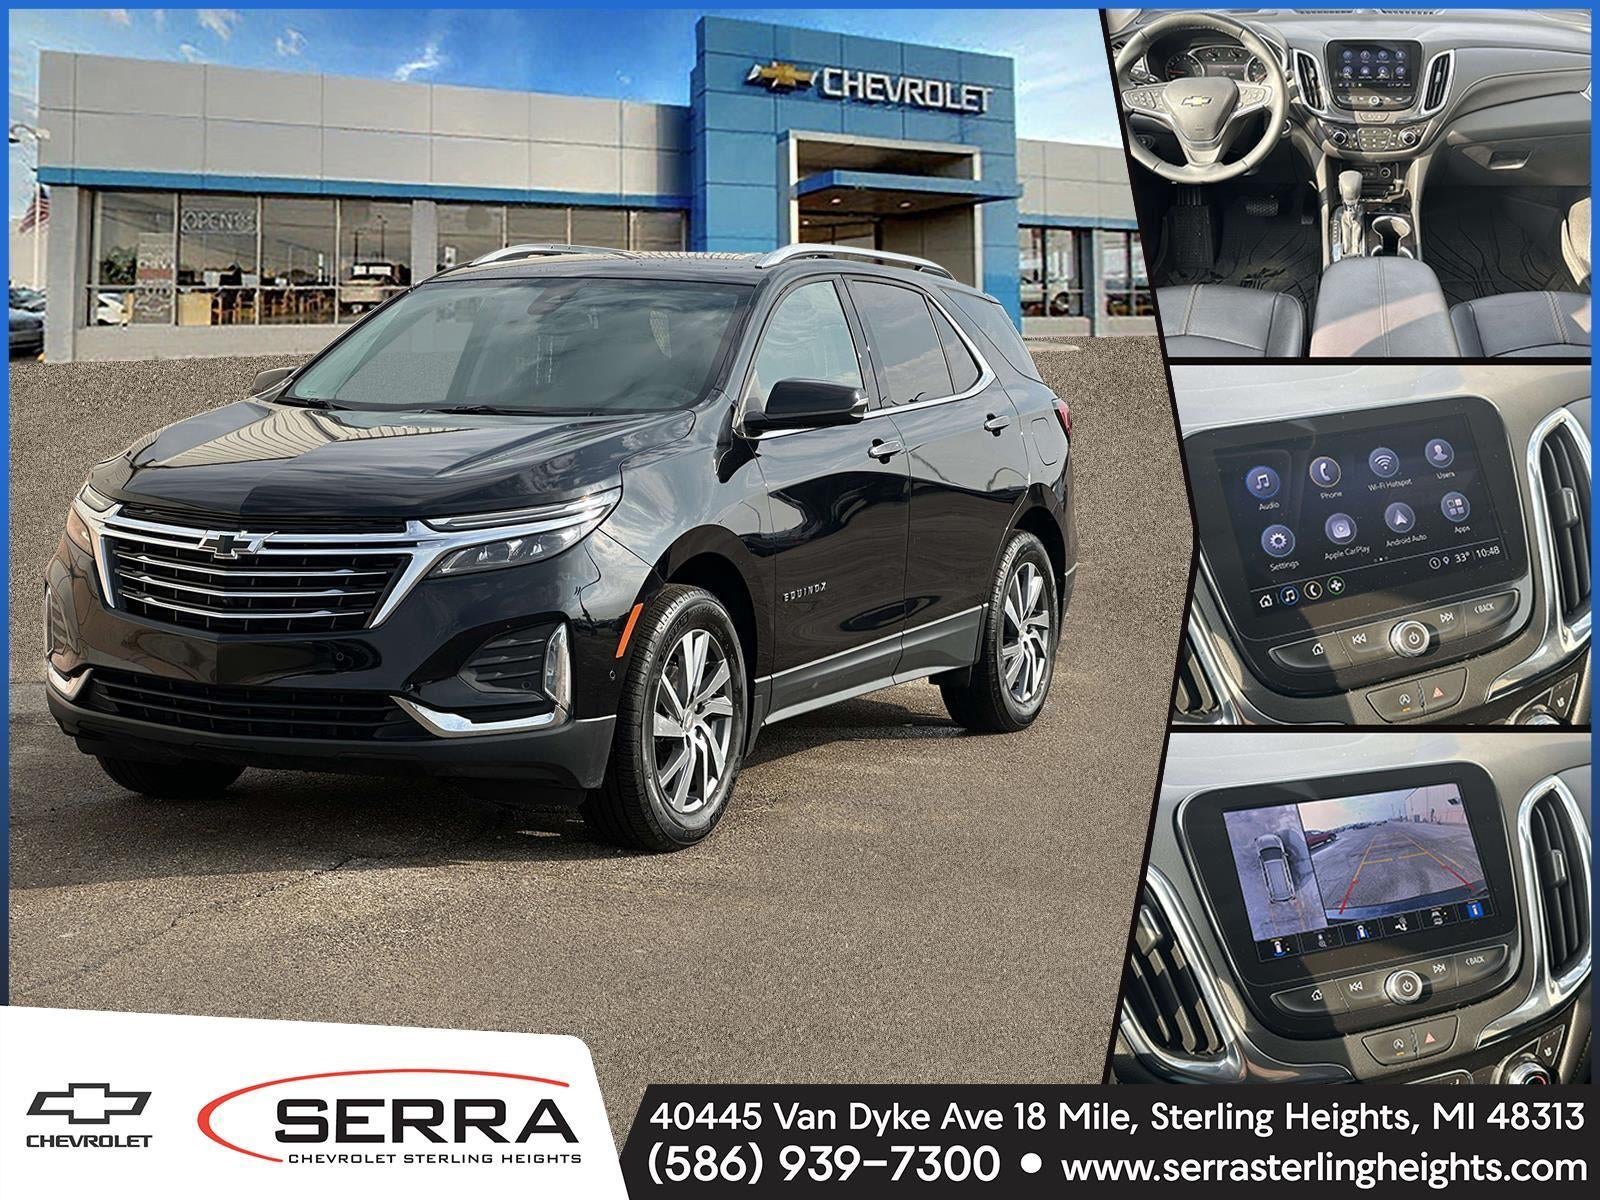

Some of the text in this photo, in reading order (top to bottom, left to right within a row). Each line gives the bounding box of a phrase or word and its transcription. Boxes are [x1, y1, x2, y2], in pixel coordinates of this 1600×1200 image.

[823, 67, 993, 111] CHEVROLET
[1436, 471, 1455, 480] Users
[1386, 478, 1413, 489] Hotspot
[1320, 491, 1342, 499] Phone
[1259, 502, 1280, 511] Audio
[1454, 525, 1471, 534] Apps
[1386, 534, 1427, 548] Android Auto
[1324, 545, 1370, 560] Apple CarPlay
[1476, 545, 1500, 559] 10:48
[1270, 560, 1300, 571] Settings
[784, 581, 827, 602] EQUINOX
